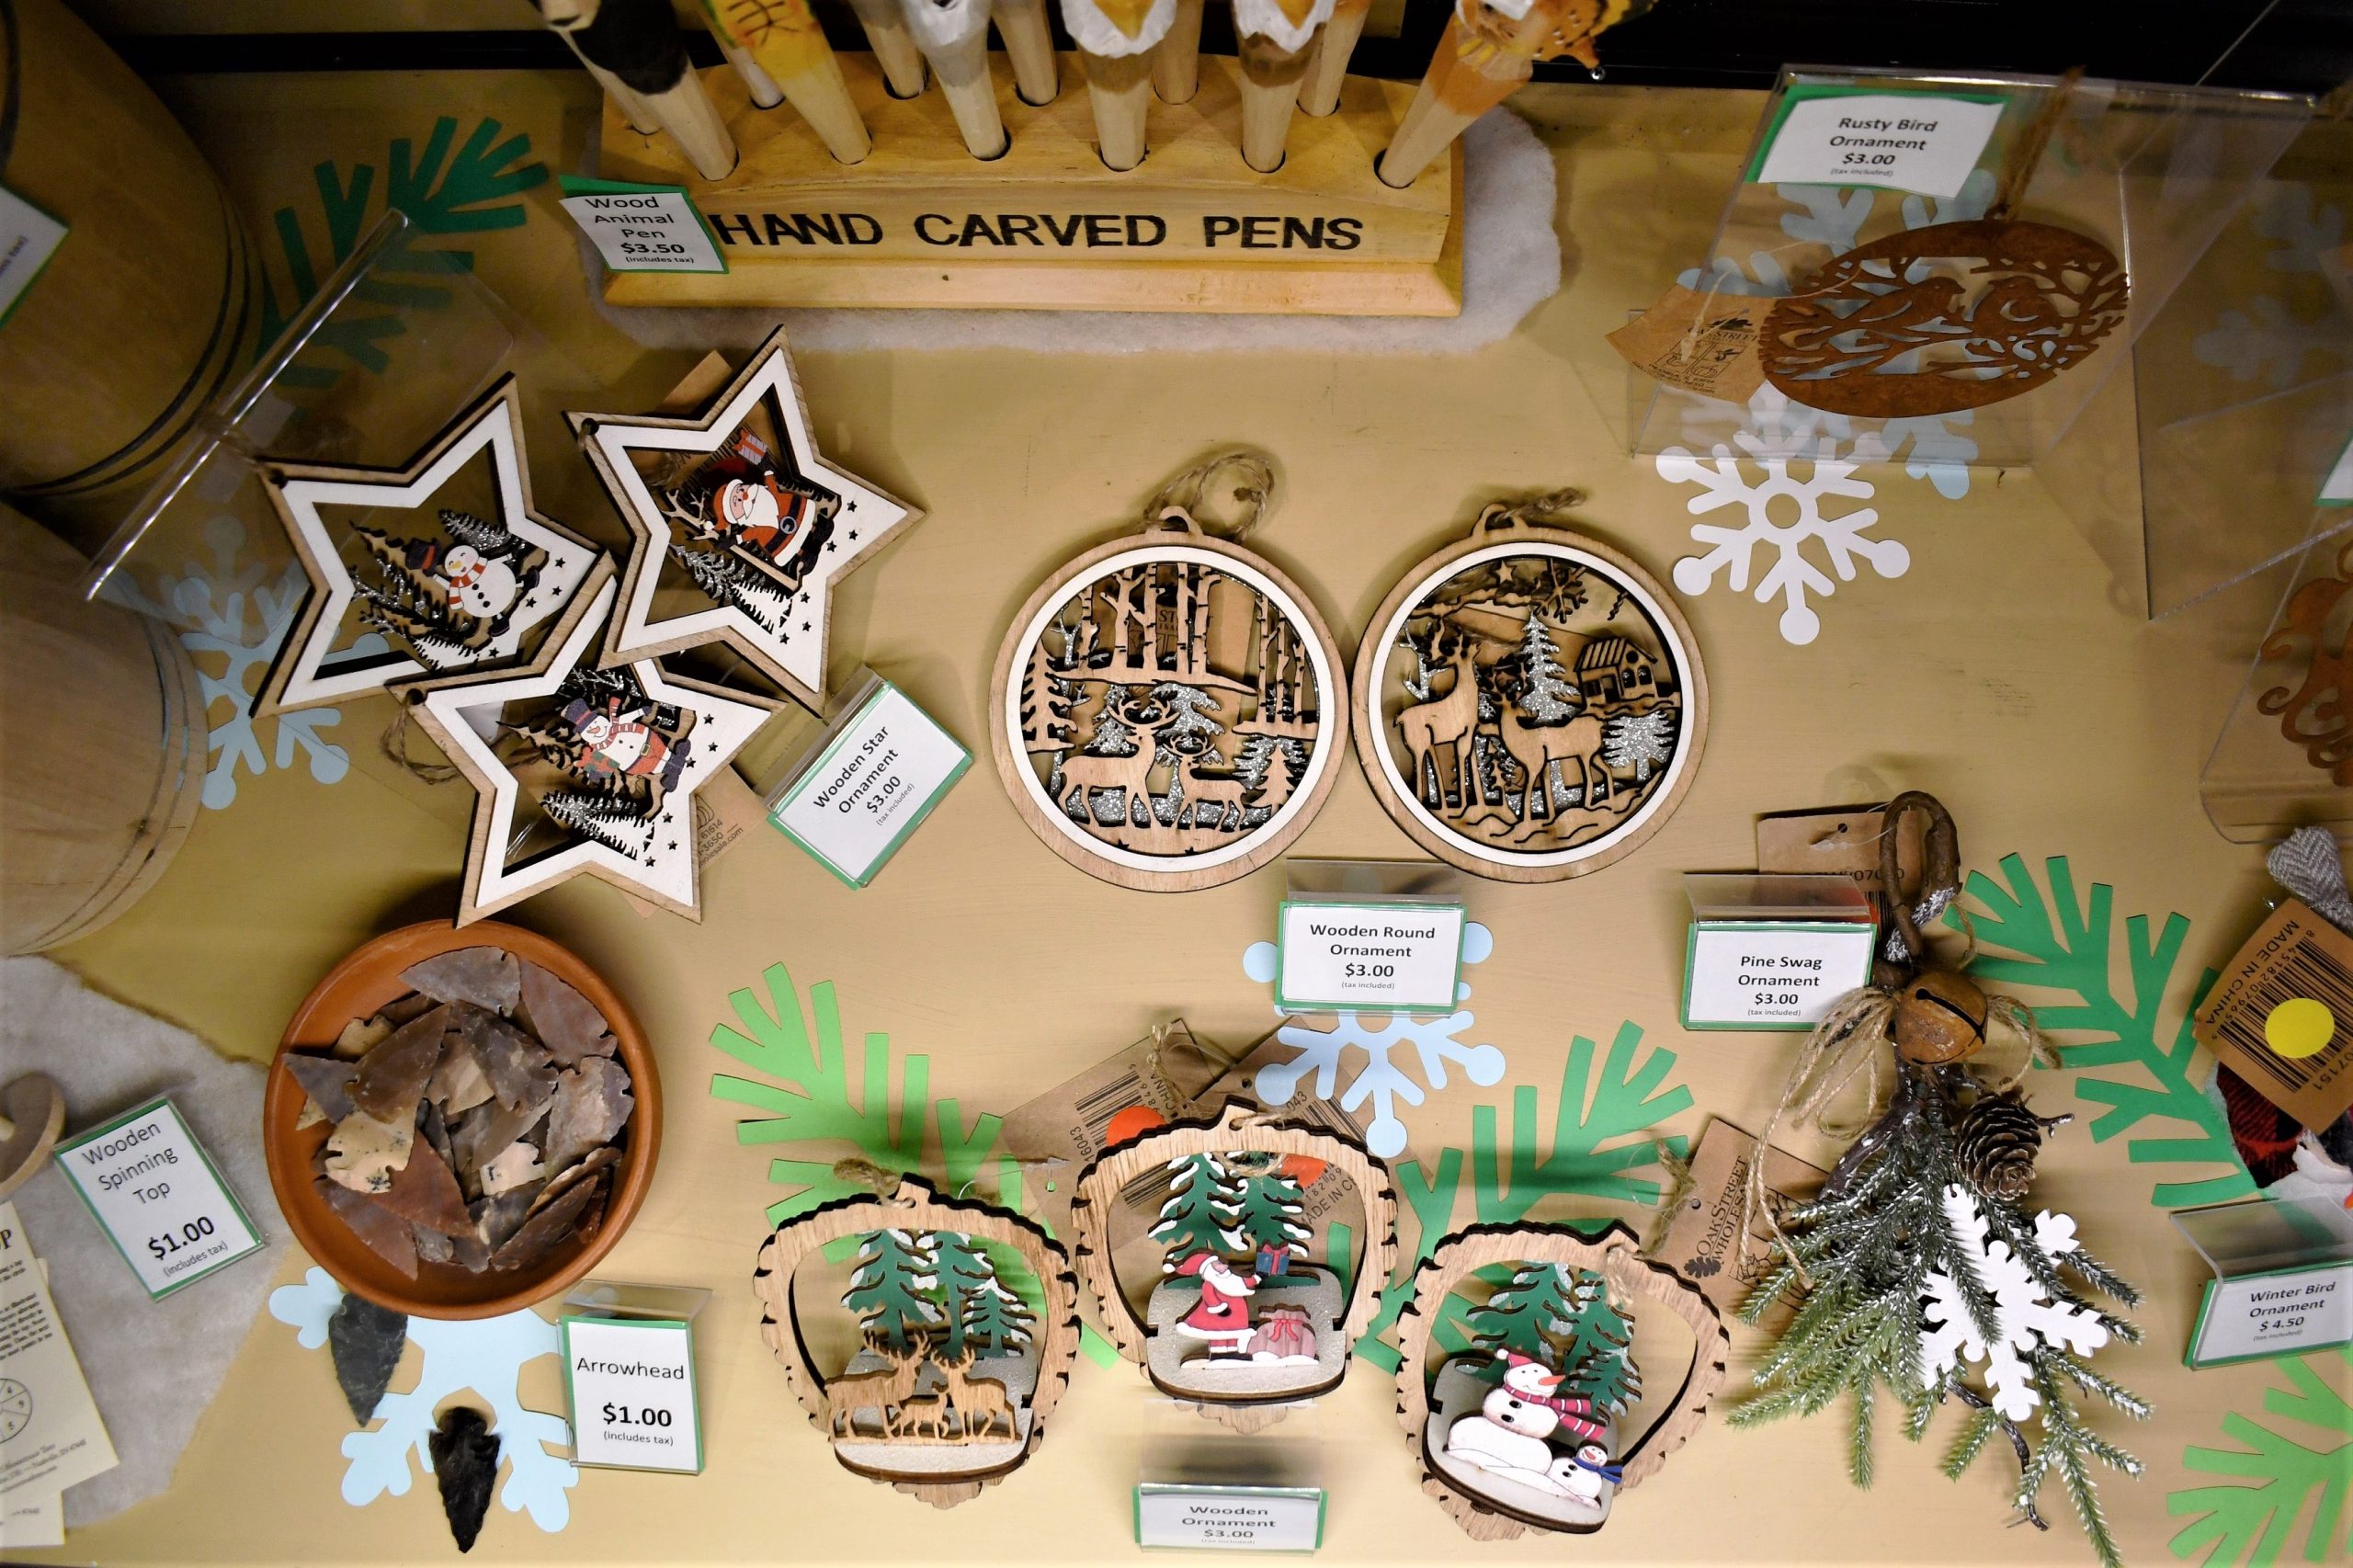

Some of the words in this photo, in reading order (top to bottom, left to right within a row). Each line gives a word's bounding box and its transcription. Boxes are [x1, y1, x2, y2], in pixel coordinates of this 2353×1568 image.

[1838, 117, 1893, 131] Rusty
[1897, 119, 1938, 131] Bird
[1829, 136, 1927, 151] Ornament
[1842, 153, 1895, 165] $3.00
[585, 196, 659, 209] Wood
[595, 213, 674, 223] Animal
[621, 229, 665, 238] Pen
[708, 213, 884, 246] HAND
[915, 213, 1167, 249] CARVED
[1203, 216, 1363, 251] PENS
[620, 242, 685, 254] $3.50
[813, 756, 866, 809] Wooden
[862, 726, 889, 755] Star
[838, 748, 899, 813] Ornament
[867, 776, 901, 813] $3.00
[876, 811, 889, 826] (tax
[888, 783, 915, 813] included)
[700, 819, 723, 839] 61614
[699, 832, 723, 856] -3650
[1310, 925, 1378, 937] Wooden
[1383, 926, 1435, 938] Round
[2256, 920, 2300, 961] MADE
[1330, 944, 1412, 957] Ornament
[1345, 962, 1394, 978] $3.00
[1741, 955, 1775, 967] Pine
[1779, 956, 1823, 971] Swag
[2241, 960, 2259, 978] IN
[1358, 981, 1395, 990] included)
[1738, 974, 1820, 987] Ornament
[1755, 992, 1798, 1006] $3.00
[2206, 979, 2243, 1024] CHINA
[1765, 1008, 1802, 1017] included)
[82, 1122, 161, 1165] Wooden
[98, 1147, 178, 1191] Spinning
[132, 1182, 171, 1205] Top
[1332, 1190, 1343, 1204] IN
[148, 1216, 214, 1261] $1.00
[163, 1251, 207, 1278] (includes
[208, 1241, 229, 1258] tax)
[2251, 1288, 2302, 1302] Winter
[2305, 1281, 2336, 1295] Bird
[2250, 1300, 2325, 1318] Ornament
[576, 1358, 684, 1380] Arrowhead
[602, 1402, 672, 1427] $1.00
[603, 1430, 651, 1443] (includes
[654, 1436, 674, 1447] tax)
[1189, 1506, 1268, 1516] Wooden
[1182, 1518, 1276, 1528] Ornament
[1204, 1528, 1254, 1539] $3.00
